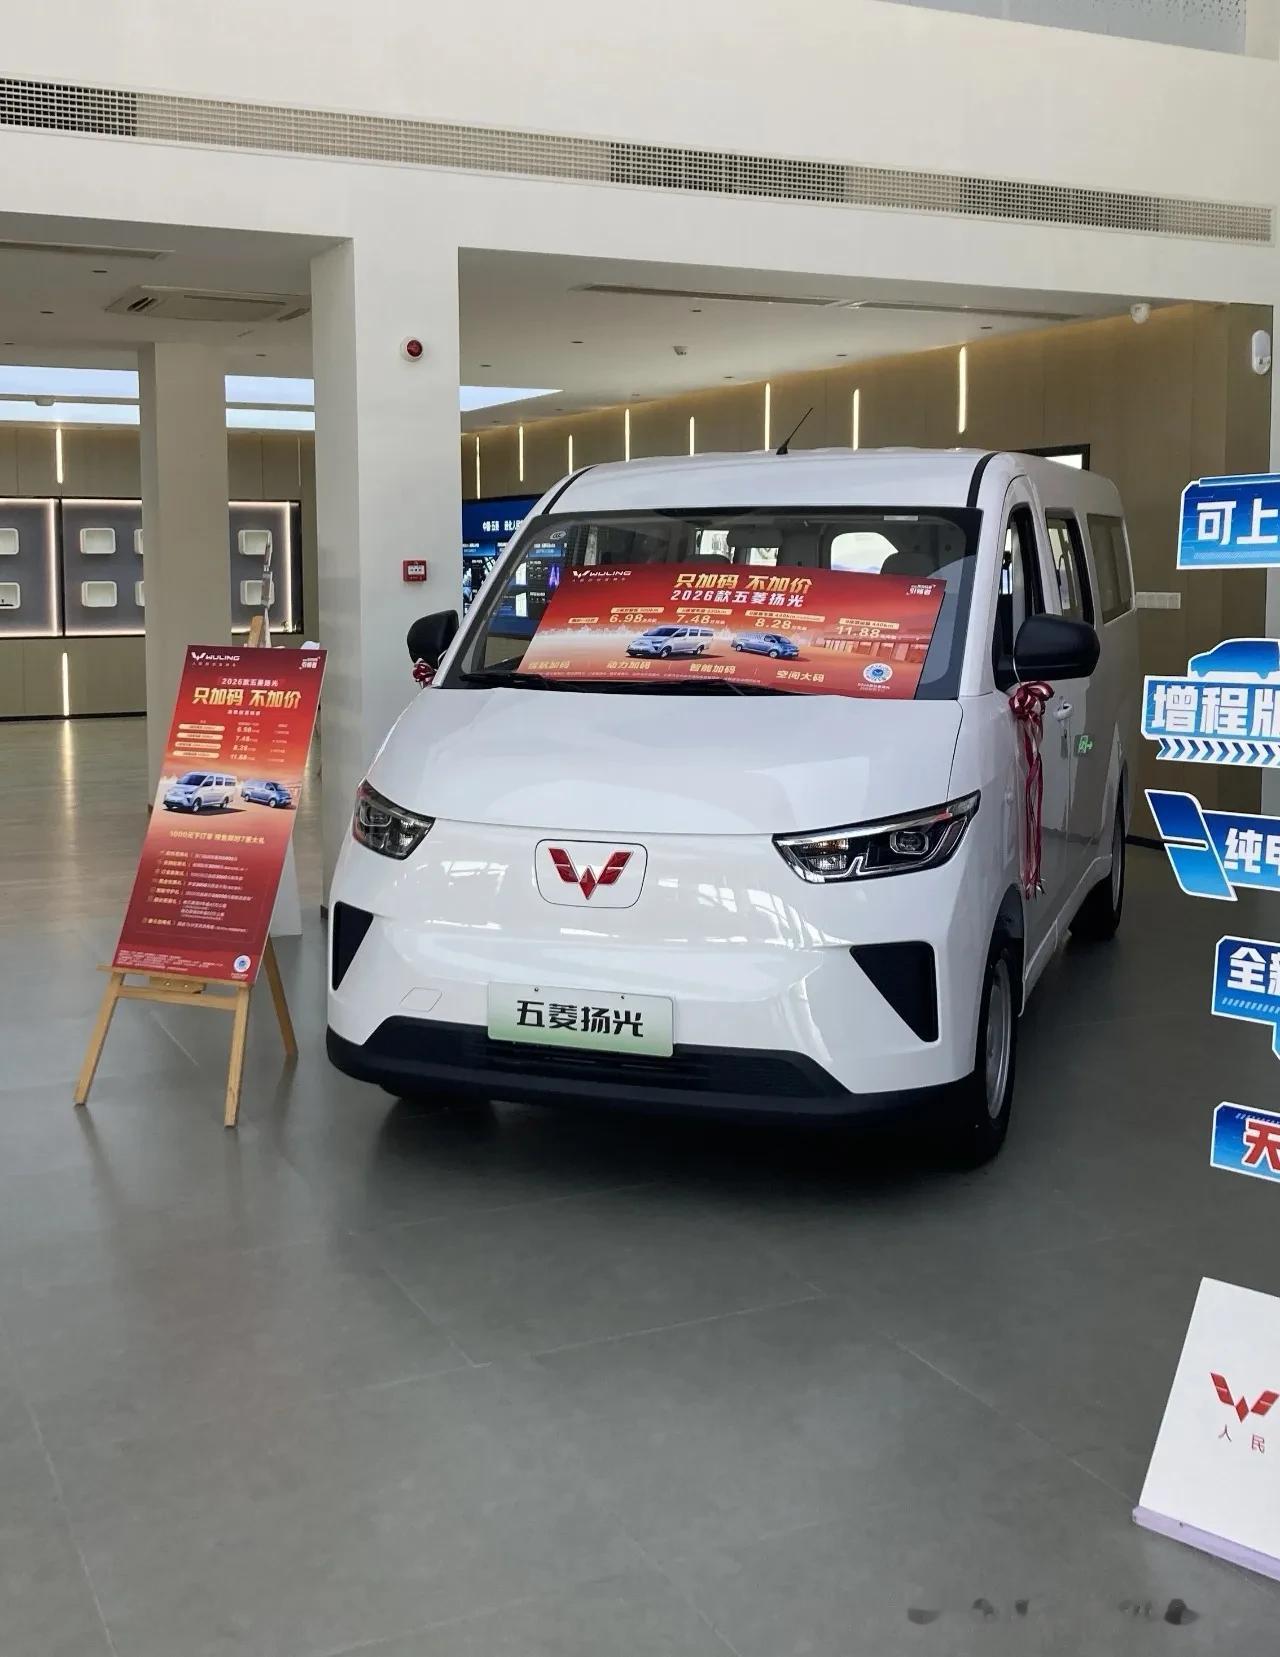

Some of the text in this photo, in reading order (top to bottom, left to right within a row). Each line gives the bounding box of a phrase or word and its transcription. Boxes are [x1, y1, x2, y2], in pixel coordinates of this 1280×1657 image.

[1196, 500, 1279, 546] 可上
[674, 573, 813, 594] 只加码 不加价
[670, 589, 805, 608] 2026款五菱扬光
[205, 654, 241, 662] WULING
[775, 669, 825, 683] 空间大码
[192, 687, 302, 709] 只加码 不加价
[1153, 684, 1280, 736] 增程版
[516, 1000, 644, 1038] 五菱扬光
